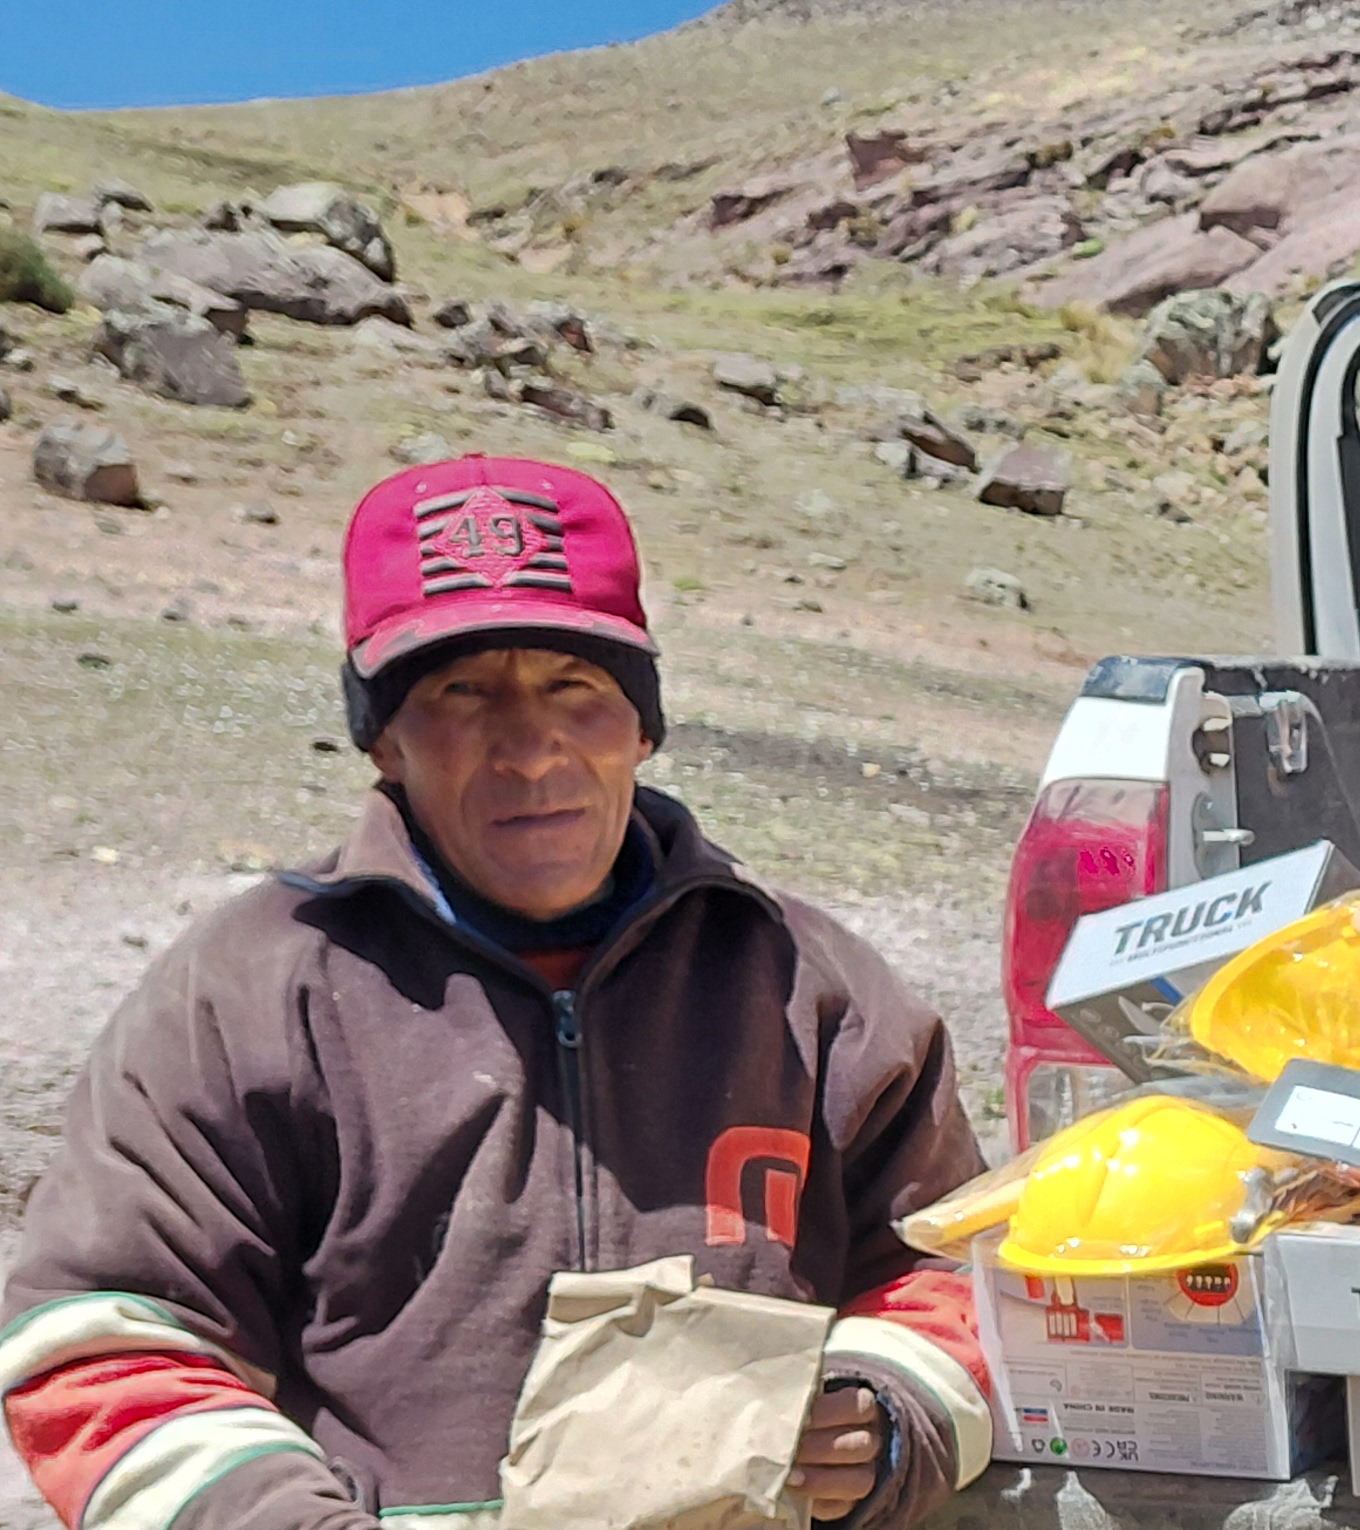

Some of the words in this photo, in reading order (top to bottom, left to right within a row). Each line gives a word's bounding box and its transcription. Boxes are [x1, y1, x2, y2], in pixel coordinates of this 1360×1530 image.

[450, 517, 525, 557] 49
[1114, 880, 1273, 955] TRUCK
[1063, 1403, 1093, 1412] CHINA
